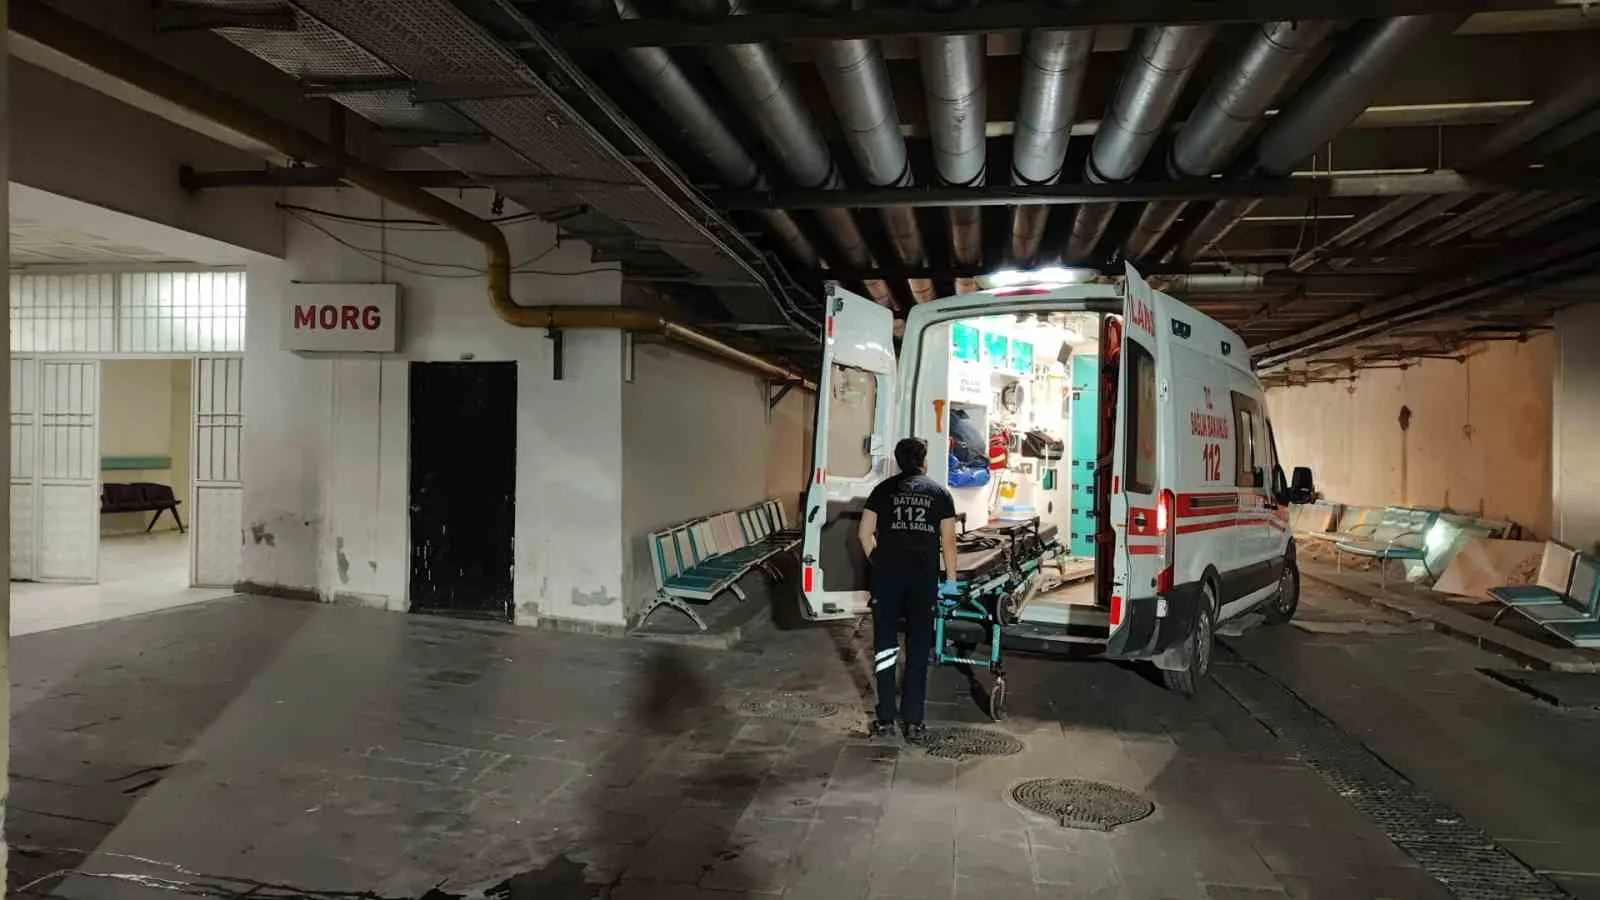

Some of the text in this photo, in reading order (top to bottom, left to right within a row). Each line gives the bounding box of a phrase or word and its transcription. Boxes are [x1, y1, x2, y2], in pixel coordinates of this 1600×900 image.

[294, 304, 381, 330] MORG
[1203, 443, 1221, 481] 112
[893, 496, 932, 509] BATMAN
[893, 506, 927, 522] 112
